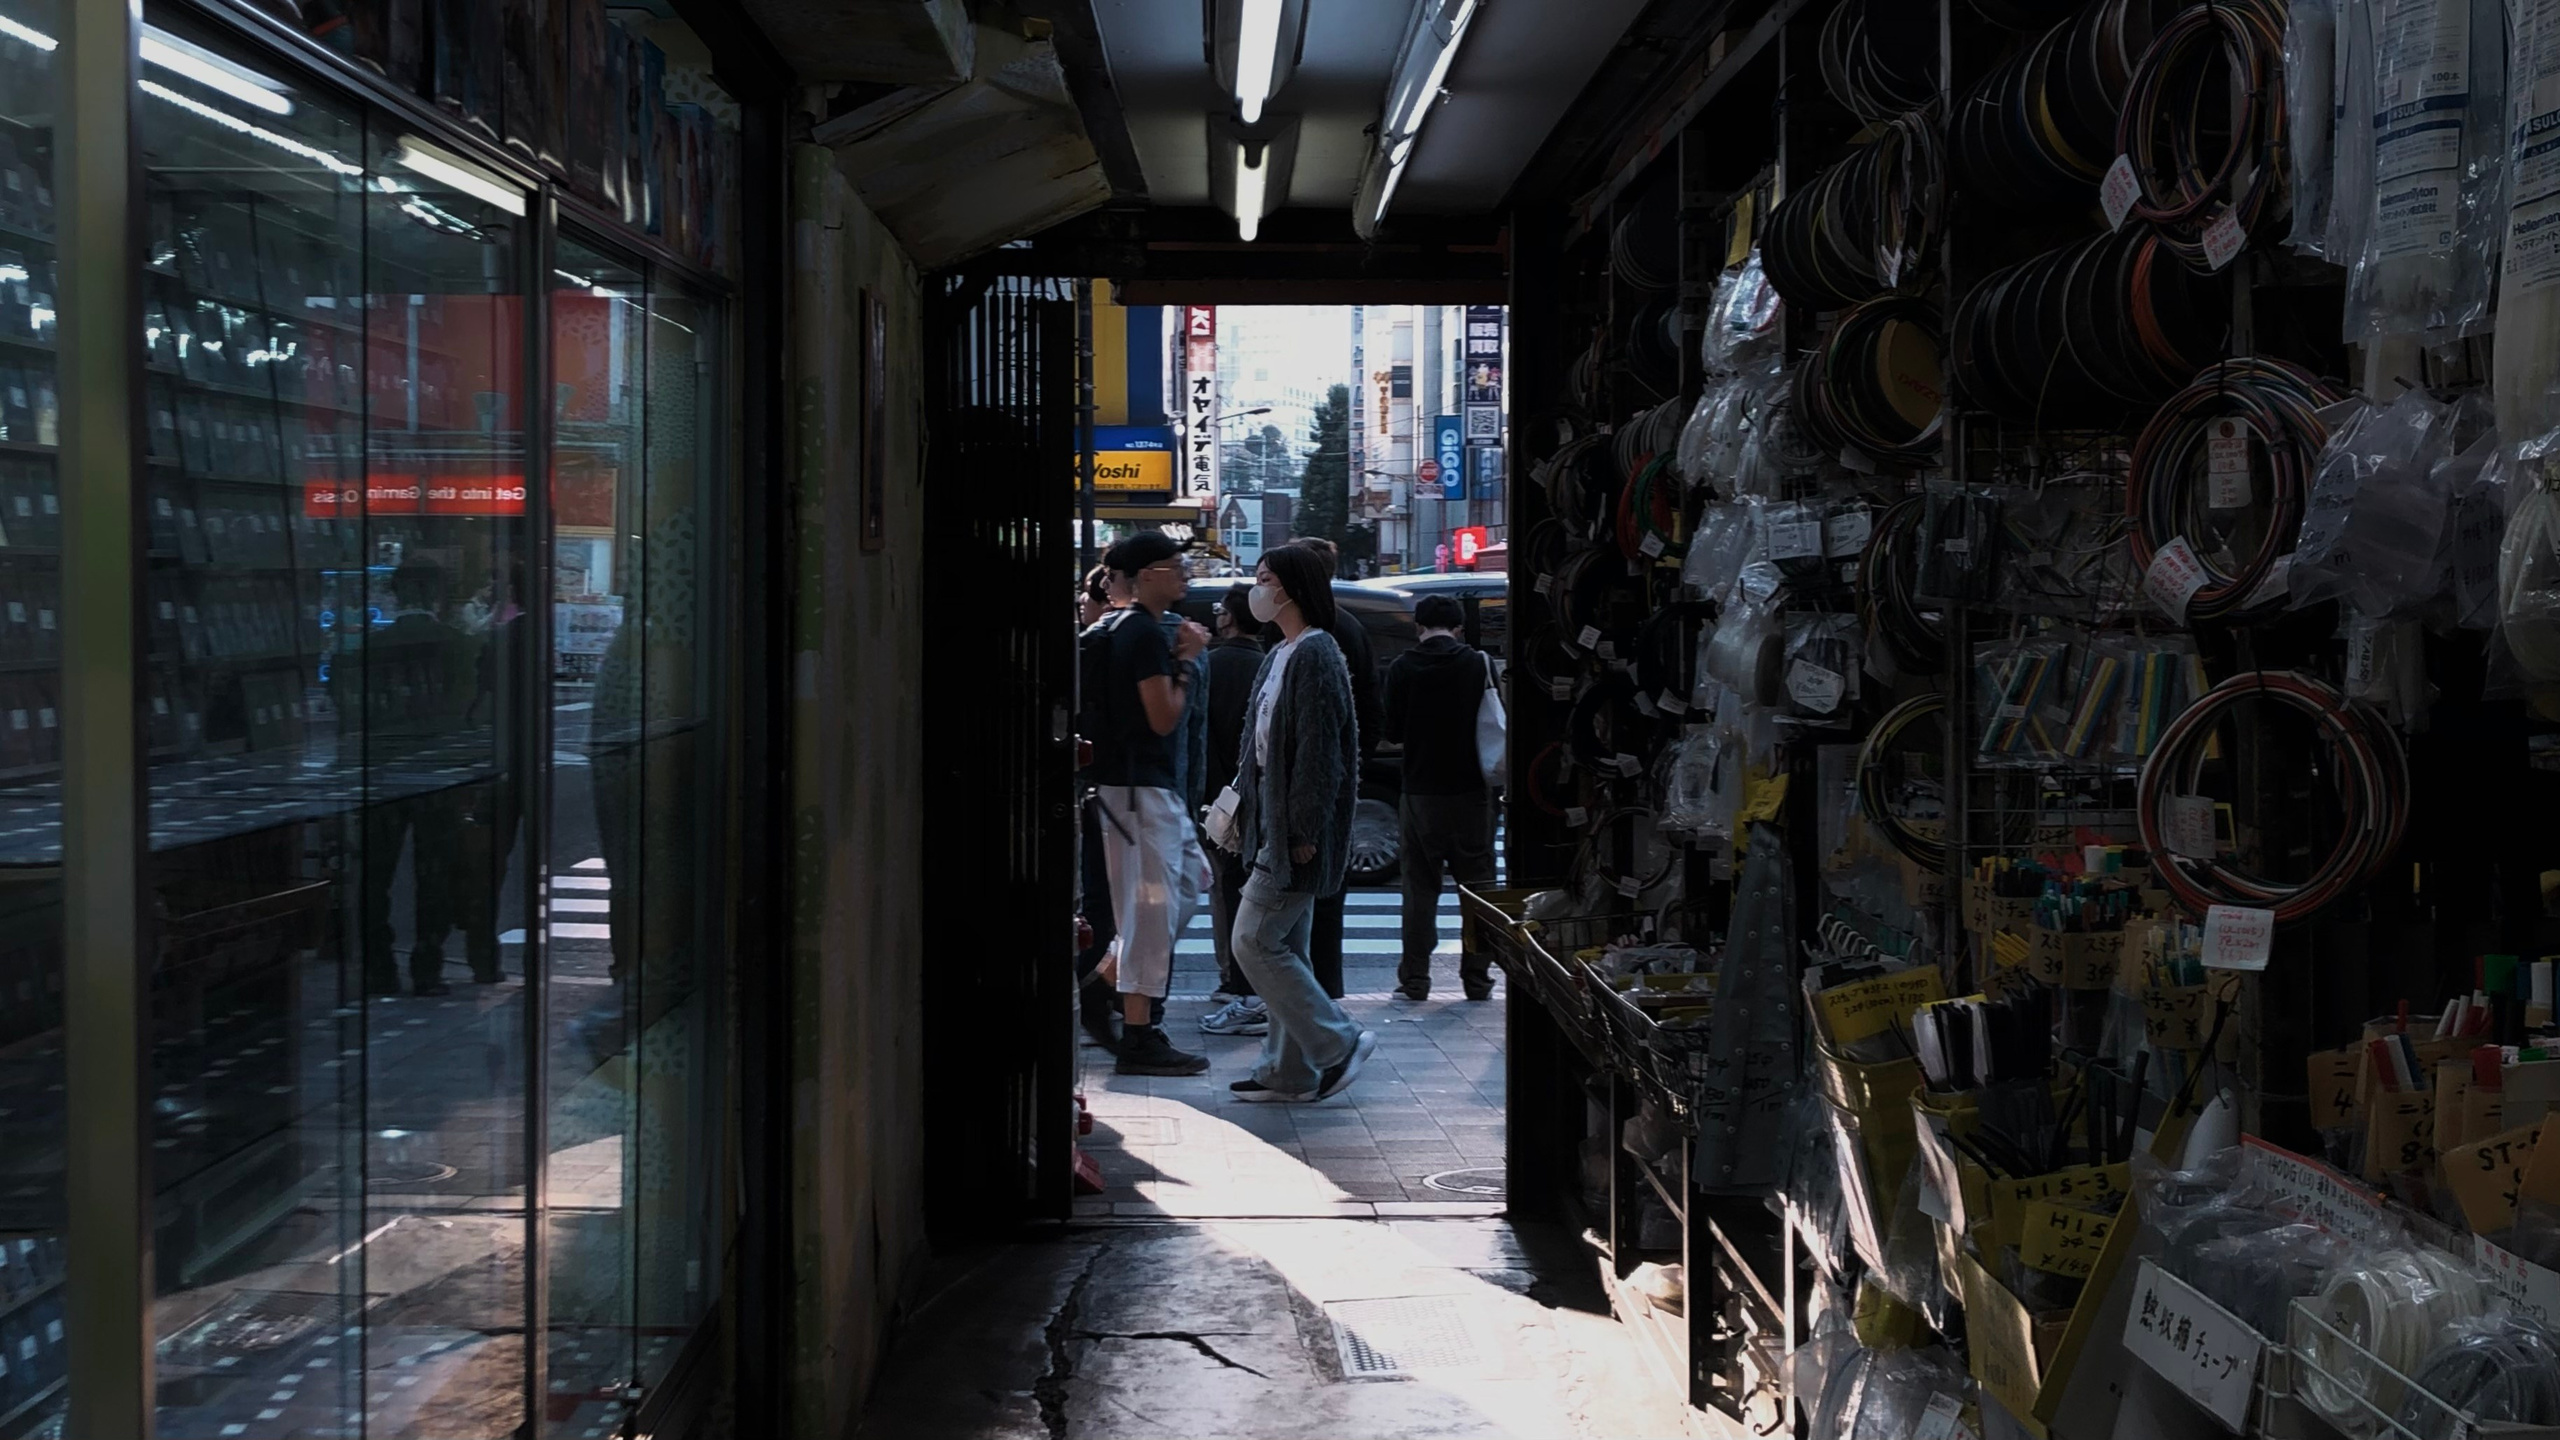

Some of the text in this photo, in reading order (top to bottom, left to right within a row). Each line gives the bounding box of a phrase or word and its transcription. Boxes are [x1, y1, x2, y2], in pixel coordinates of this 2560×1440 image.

[1192, 376, 1213, 492] オヤイデ電気
[2139, 1287, 2240, 1381] 熱収縮チューブ
